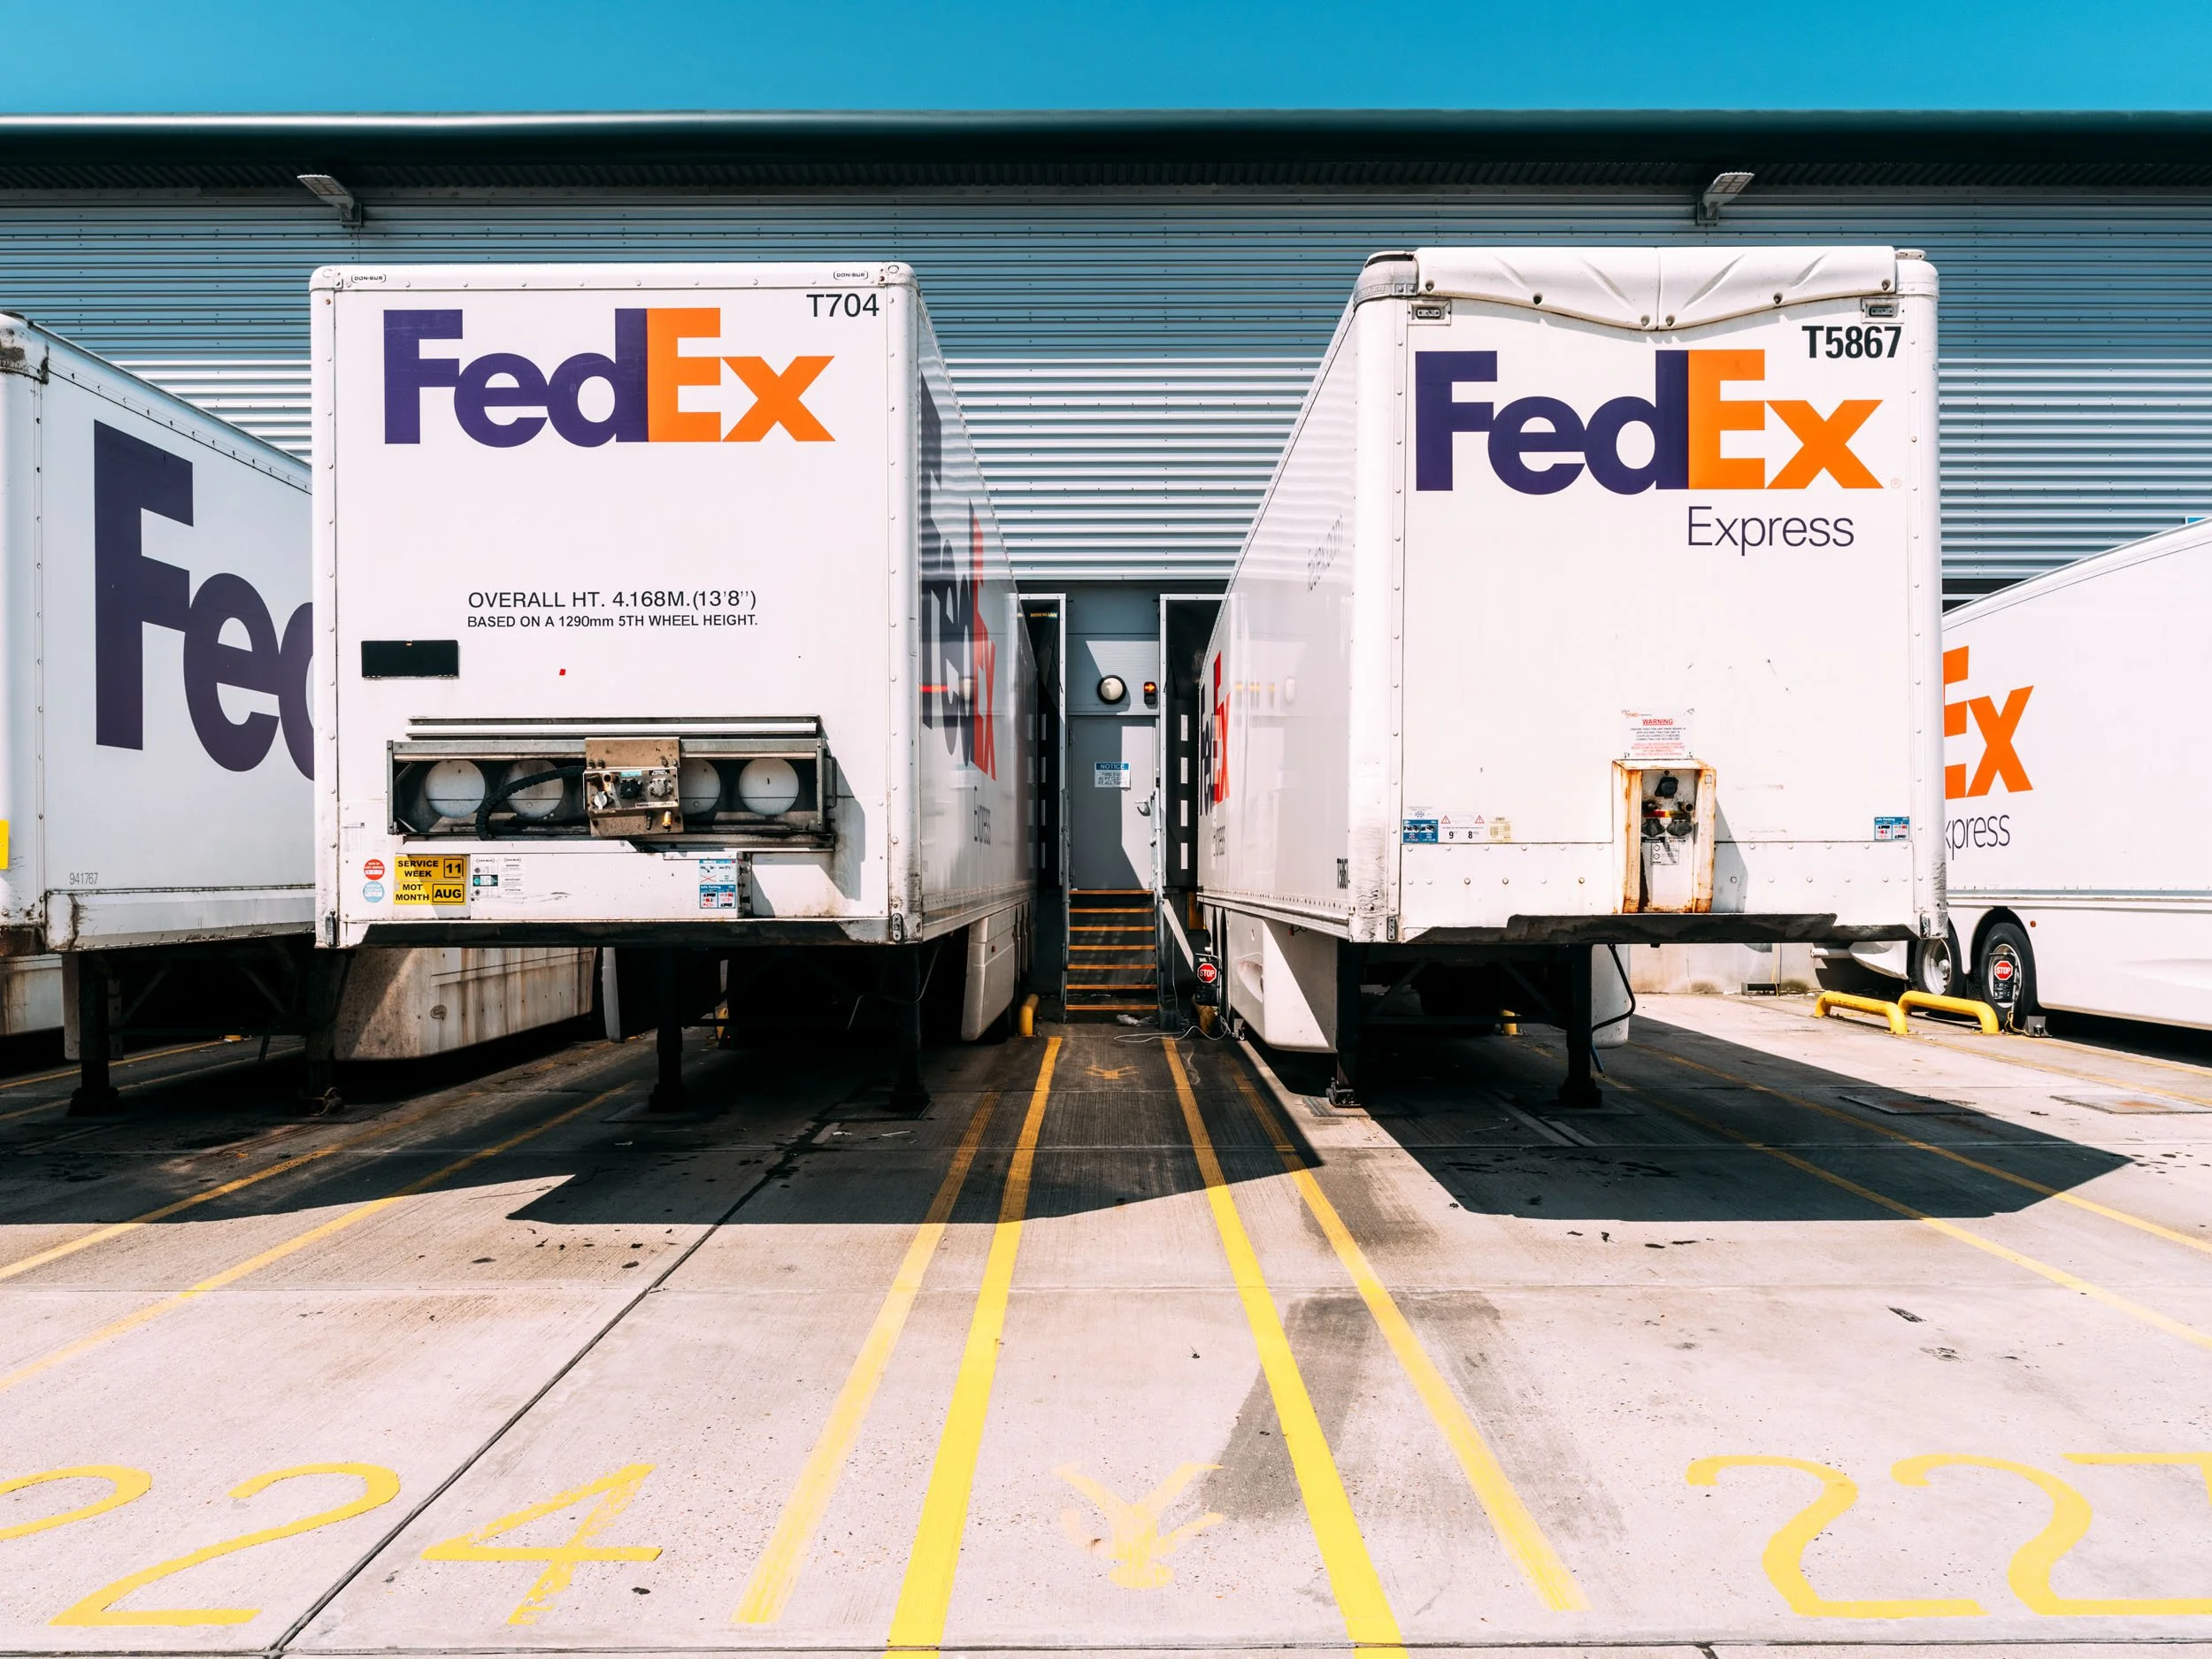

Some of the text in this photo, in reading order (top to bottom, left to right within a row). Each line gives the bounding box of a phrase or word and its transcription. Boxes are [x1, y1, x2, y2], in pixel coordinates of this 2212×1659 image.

[806, 293, 880, 319] T704
[1802, 325, 1902, 359] T5867
[384, 307, 836, 448] FedEx
[1416, 349, 1884, 495] FedEx
[1687, 505, 1855, 557] Express
[468, 592, 566, 608] OVERALL
[572, 592, 605, 608] HT.
[467, 614, 758, 627] BASED ON A 1290mm 5TH WHEEL HEIGHT.
[446, 864, 461, 873] 11
[69, 872, 98, 885] 941767
[434, 889, 461, 898] AUG
[1996, 966, 2011, 975] STOP
